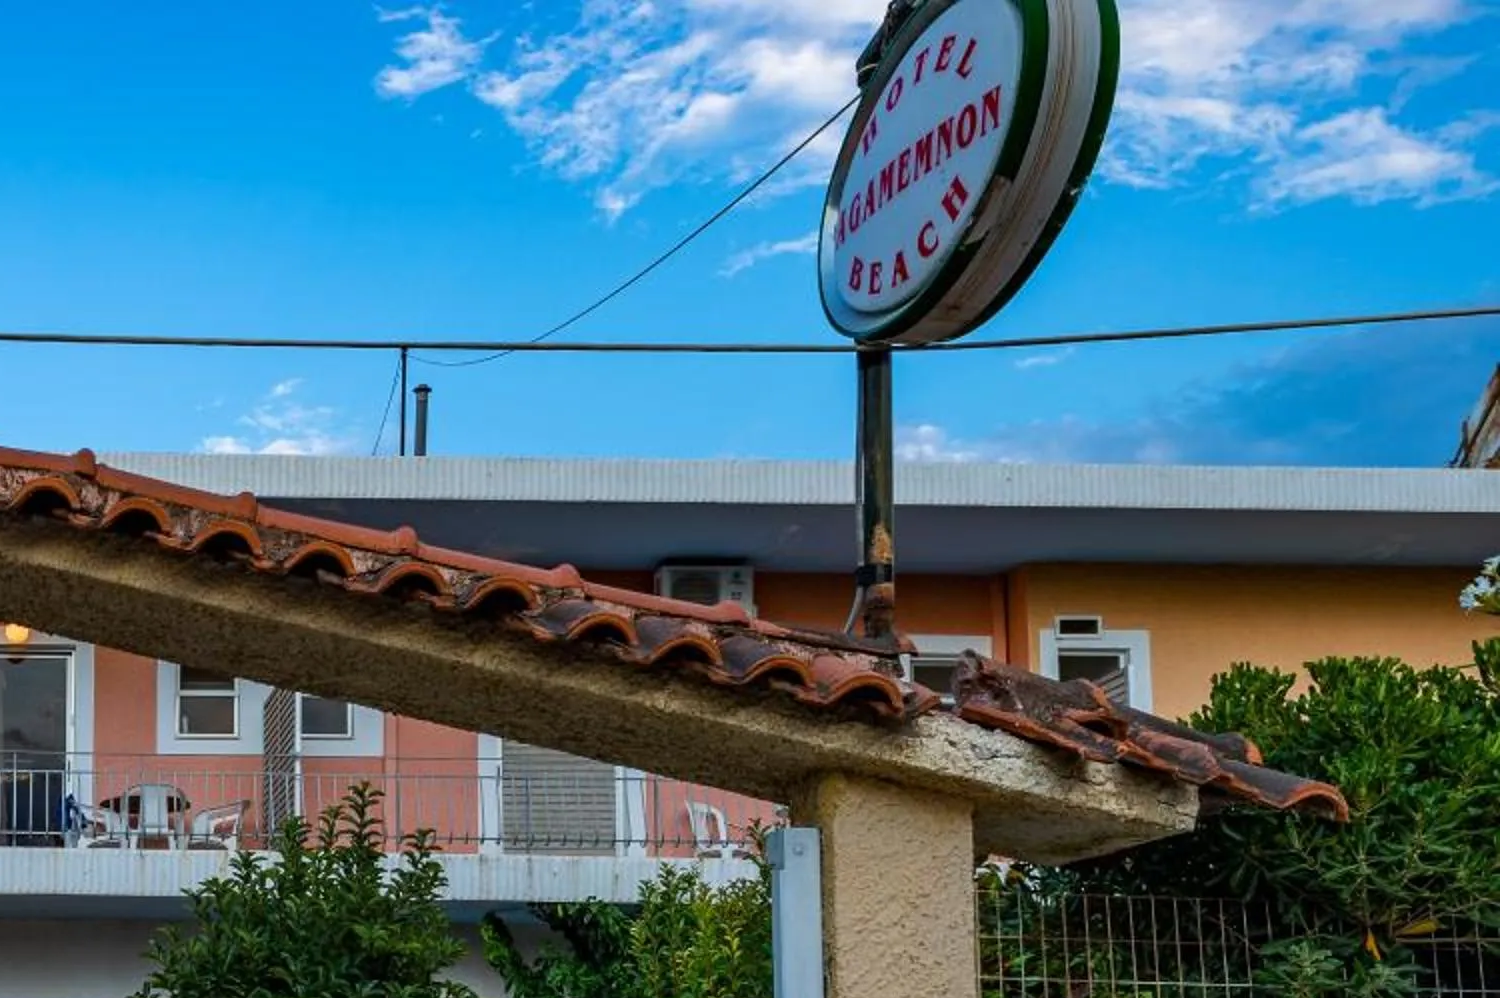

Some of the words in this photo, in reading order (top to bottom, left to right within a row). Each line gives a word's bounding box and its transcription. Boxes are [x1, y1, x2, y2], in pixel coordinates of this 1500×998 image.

[861, 34, 977, 156] HOTEL
[836, 84, 1002, 245] AGAMEMNON
[848, 175, 970, 295] BEACH
